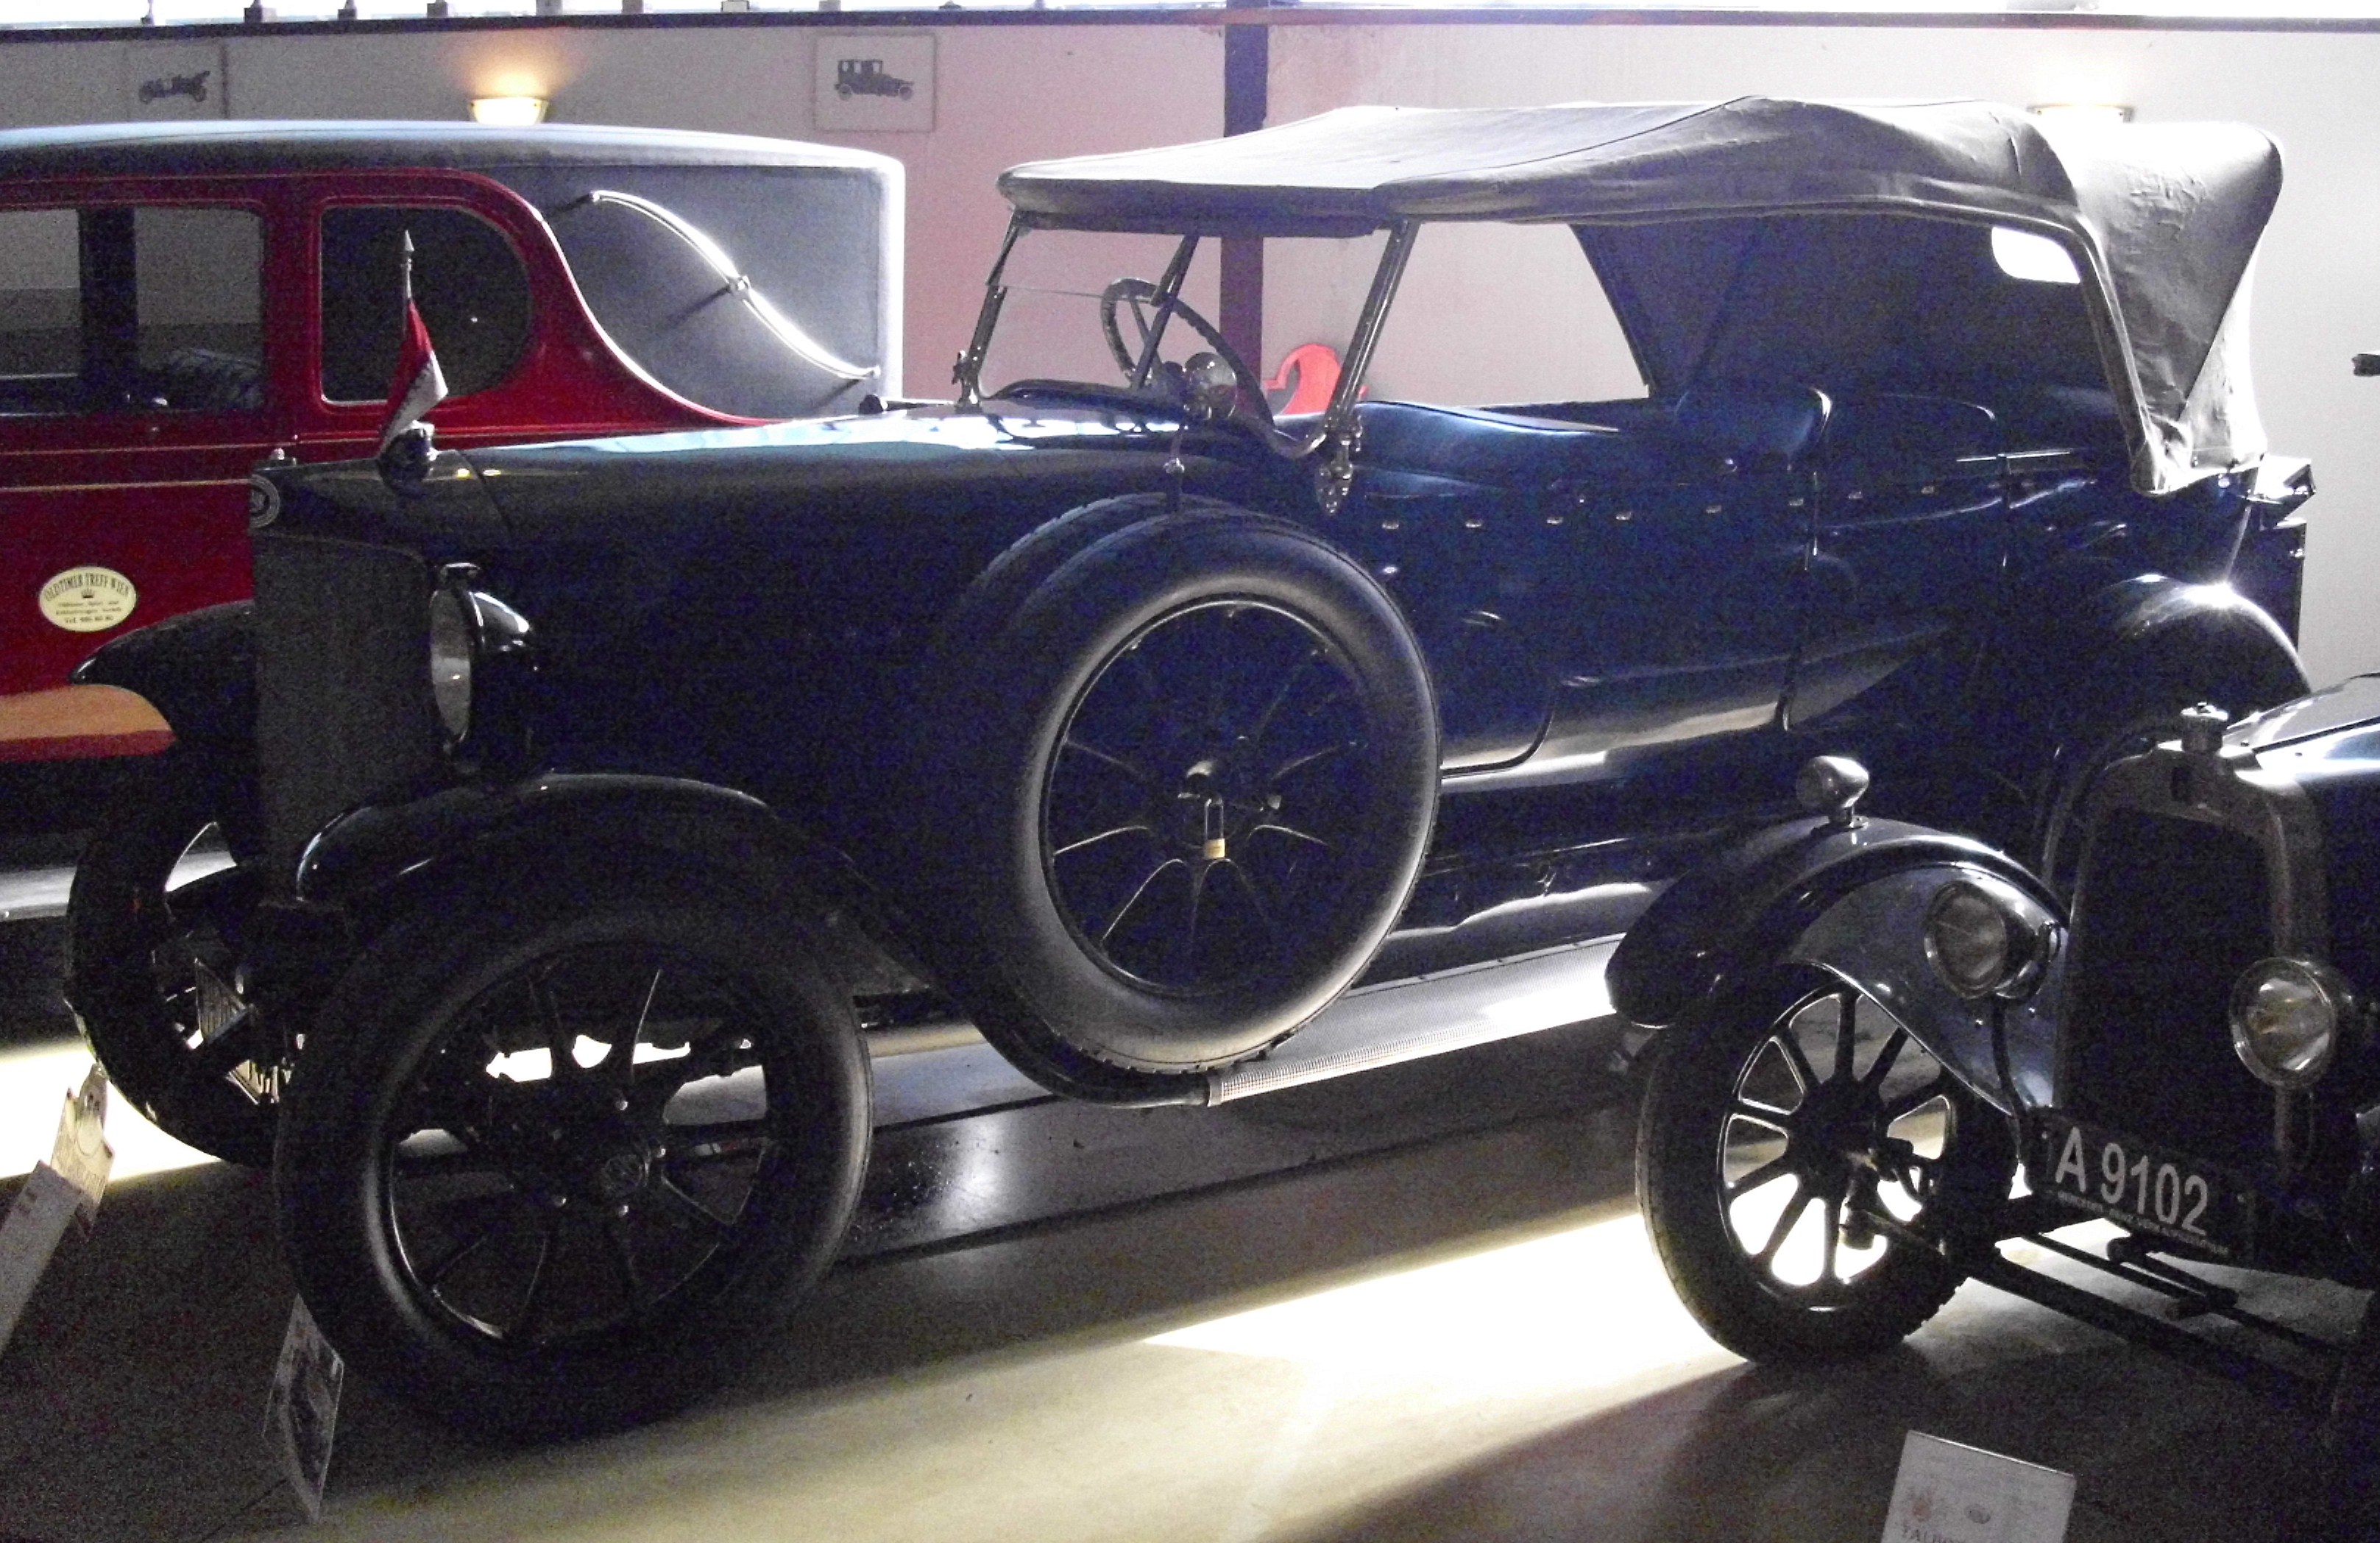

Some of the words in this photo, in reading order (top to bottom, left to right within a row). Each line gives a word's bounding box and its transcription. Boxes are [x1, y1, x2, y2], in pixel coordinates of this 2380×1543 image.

[85, 573, 108, 587] TREFF
[2055, 1126, 2086, 1193] A
[2102, 1143, 2208, 1235] 9102
